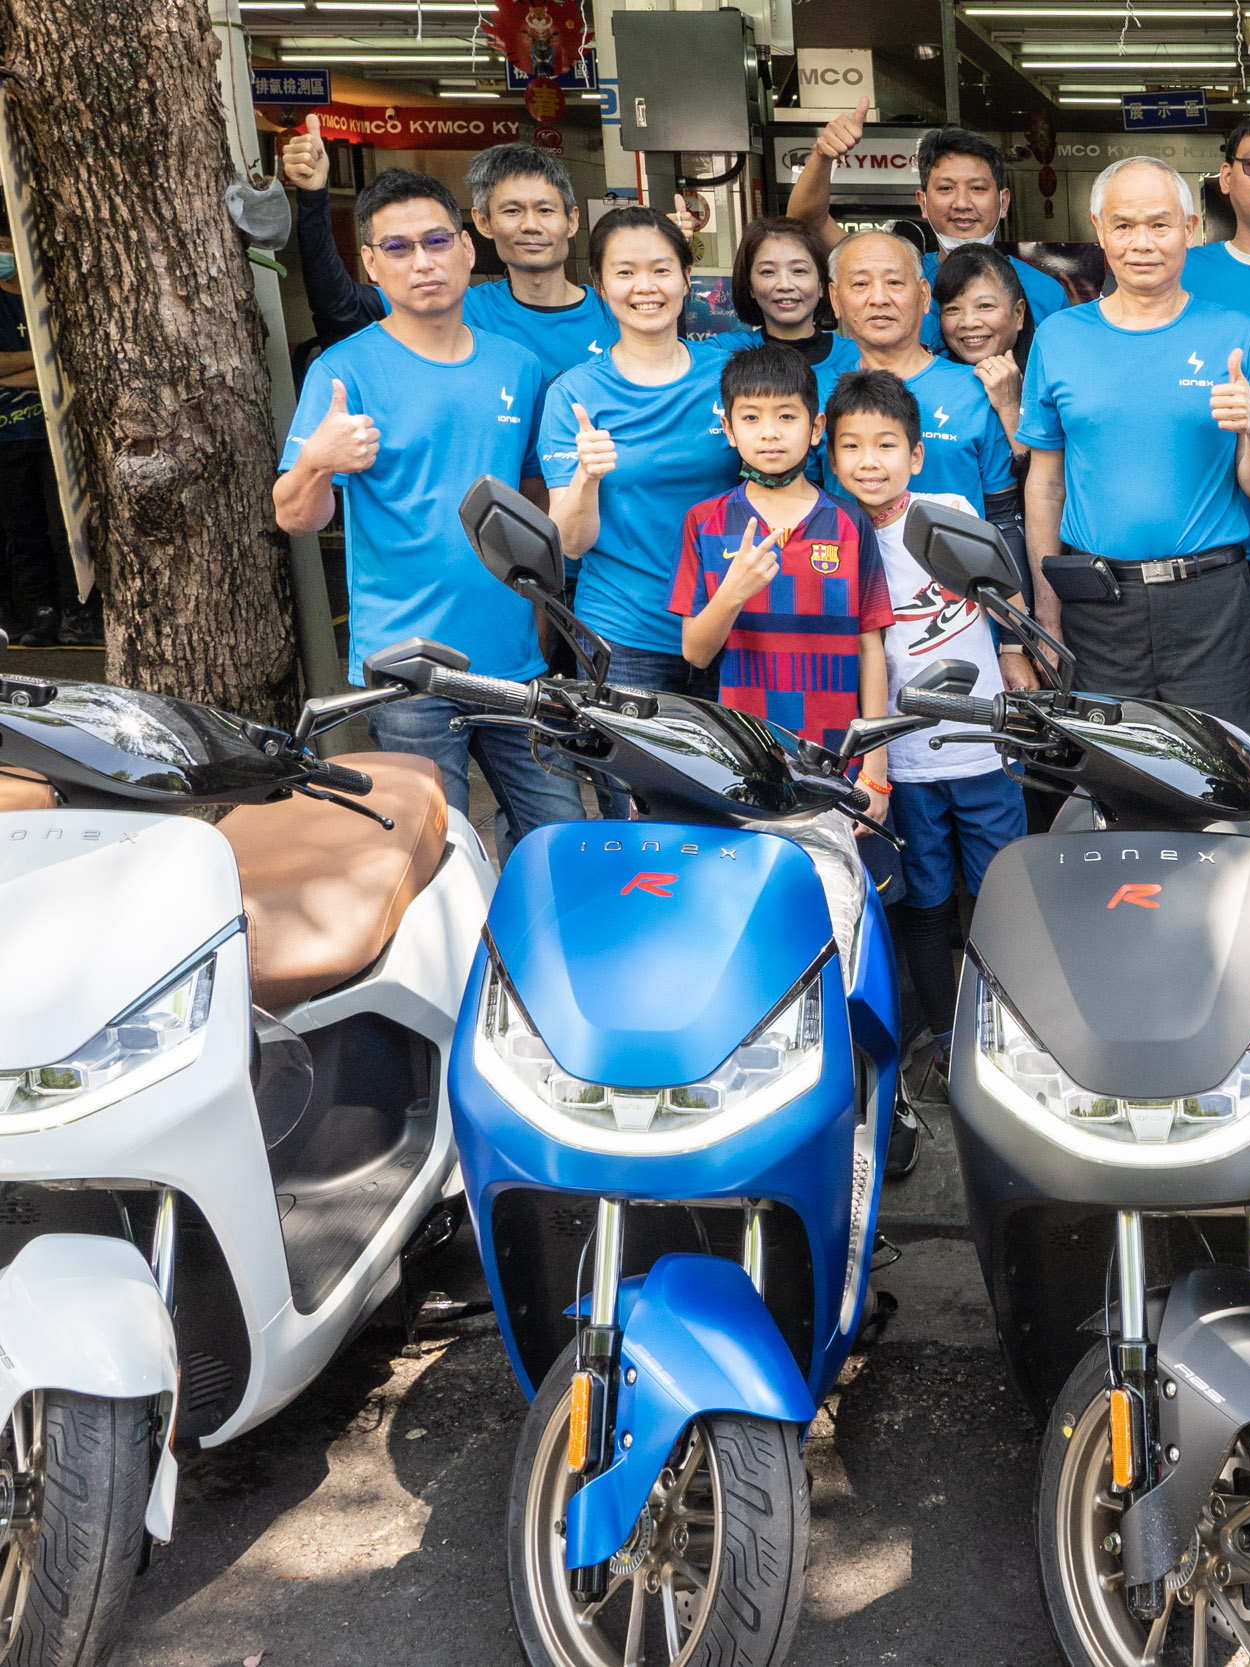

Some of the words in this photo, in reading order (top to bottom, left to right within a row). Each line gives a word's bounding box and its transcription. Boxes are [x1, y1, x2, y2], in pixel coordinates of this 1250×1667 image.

[800, 67, 863, 86] MCO
[255, 77, 325, 96] 排氣檢測區
[1129, 99, 1200, 121] 展示區
[350, 118, 402, 134] KYMCO
[410, 120, 485, 134] KYMCO
[1058, 144, 1100, 157] MCO
[10, 827, 139, 845] onex
[580, 840, 737, 861] ionex
[1059, 849, 1216, 865] ionex
[620, 871, 679, 898] R
[1106, 883, 1163, 910] R
